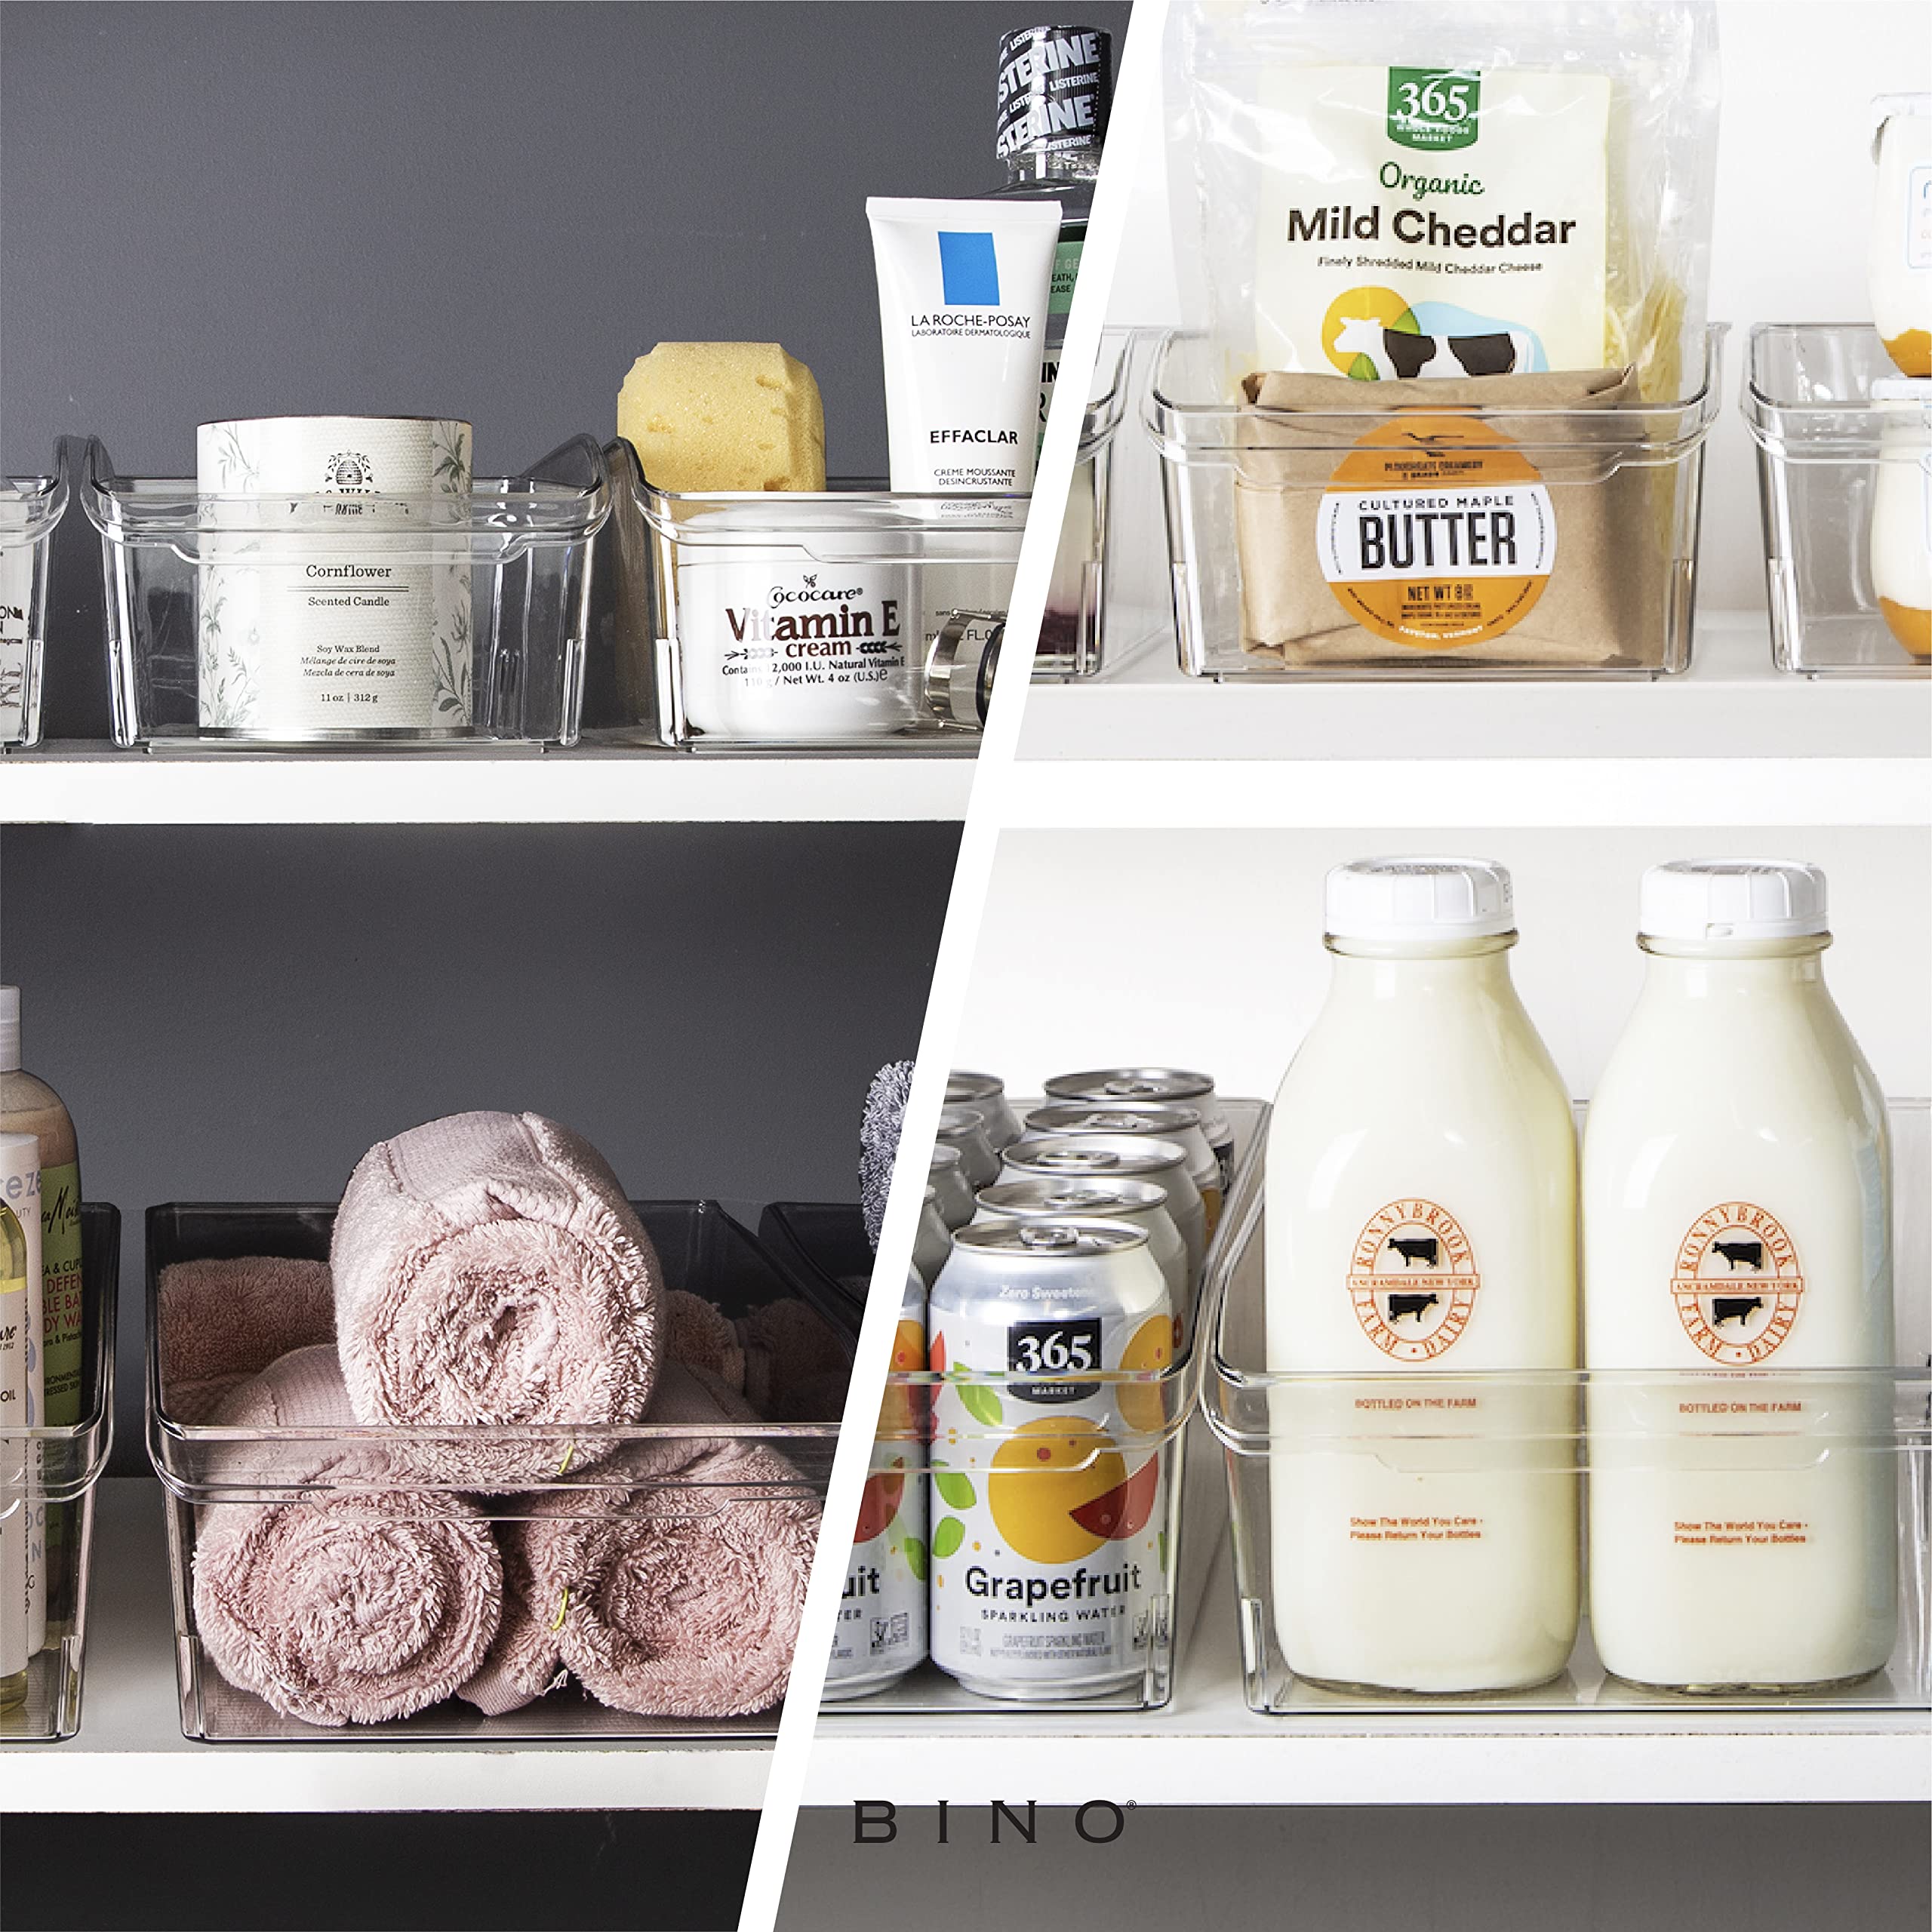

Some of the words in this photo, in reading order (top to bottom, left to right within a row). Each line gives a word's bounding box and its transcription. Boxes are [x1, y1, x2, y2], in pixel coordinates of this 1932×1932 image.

[1049, 72, 1100, 91] LISTERINE
[1397, 80, 1469, 121] 365
[1380, 162, 1484, 201] Organic
[1287, 205, 1380, 242] Mild
[1392, 209, 1576, 248] Cheddar
[1318, 255, 1352, 269] Finely
[1357, 255, 1414, 269] Shredded
[1416, 260, 1441, 273] Mild
[1444, 263, 1496, 274] Cheddar
[1498, 261, 1543, 273] Cheese
[912, 315, 930, 327] LA
[933, 314, 1031, 328] ROCHE-POSAY
[912, 328, 964, 337] LABORATOIRE
[964, 329, 1031, 339] DERMATOLOGIQUE
[930, 429, 1018, 445] EFFACLAR
[934, 468, 964, 477] CREME
[967, 468, 1016, 478] MOUSSANTE
[939, 477, 1013, 487] DESINCRUSTANTE
[1359, 497, 1449, 511] CULTURED
[1457, 495, 1514, 509] MAPLE
[1358, 511, 1517, 570] BUTTER
[306, 564, 392, 578] Cornflower
[1407, 586, 1429, 601] NET
[308, 596, 351, 606] Scented
[353, 596, 389, 606] Candle
[725, 604, 875, 642] Vitamin
[881, 600, 901, 636] E
[316, 644, 333, 654] Soy
[335, 645, 355, 653] Wax
[355, 644, 380, 653] Blend
[786, 640, 852, 658] cream
[337, 656, 348, 665] de
[348, 657, 365, 665] cire
[366, 656, 377, 665] de
[377, 658, 396, 666] soya
[805, 658, 825, 670] I.U.
[829, 657, 866, 670] Natural
[869, 656, 899, 668] Vitamin
[303, 668, 333, 677] Mezcla
[334, 668, 345, 676] de
[365, 668, 376, 676] de
[377, 669, 395, 678] soya
[783, 675, 802, 685] Net
[805, 673, 825, 684] Wt.
[828, 674, 834, 682] 4
[838, 675, 850, 683] oz
[321, 694, 331, 702] 11
[353, 693, 371, 702] 312
[372, 694, 378, 703] g
[1355, 1202, 1471, 1267] RONNYBROOK
[1679, 1206, 1792, 1271] RONNYBROOK
[1016, 1331, 1092, 1373] 365
[1355, 1398, 1403, 1410] BOTTLED
[1406, 1398, 1421, 1409] ON
[1424, 1398, 1444, 1409] THE
[1447, 1398, 1477, 1409] FARM
[1679, 1403, 1727, 1414] BOTTLED
[1731, 1401, 1747, 1413] ON
[1749, 1402, 1769, 1413] THE
[1772, 1401, 1801, 1412] FARM
[1350, 1517, 1377, 1527] Show
[1380, 1517, 1398, 1527] The
[1401, 1517, 1429, 1527] World
[1432, 1517, 1451, 1527] You
[1454, 1515, 1476, 1527] Care
[1675, 1521, 1701, 1531] Show
[1705, 1521, 1721, 1531] The
[1725, 1521, 1755, 1531] World
[1757, 1521, 1776, 1531] You
[1779, 1520, 1801, 1531] Care
[1350, 1531, 1381, 1540] Please
[1385, 1531, 1418, 1540] Return
[1420, 1531, 1444, 1540] Your
[1445, 1529, 1481, 1540] Bottles
[1675, 1535, 1706, 1545] Please
[1710, 1534, 1743, 1545] Return
[1745, 1534, 1768, 1545] Your
[1770, 1533, 1805, 1544] Bottles
[965, 1563, 1142, 1609] Grapefruit
[981, 1609, 1069, 1623] SPARKLING
[1075, 1604, 1126, 1620] WATER
